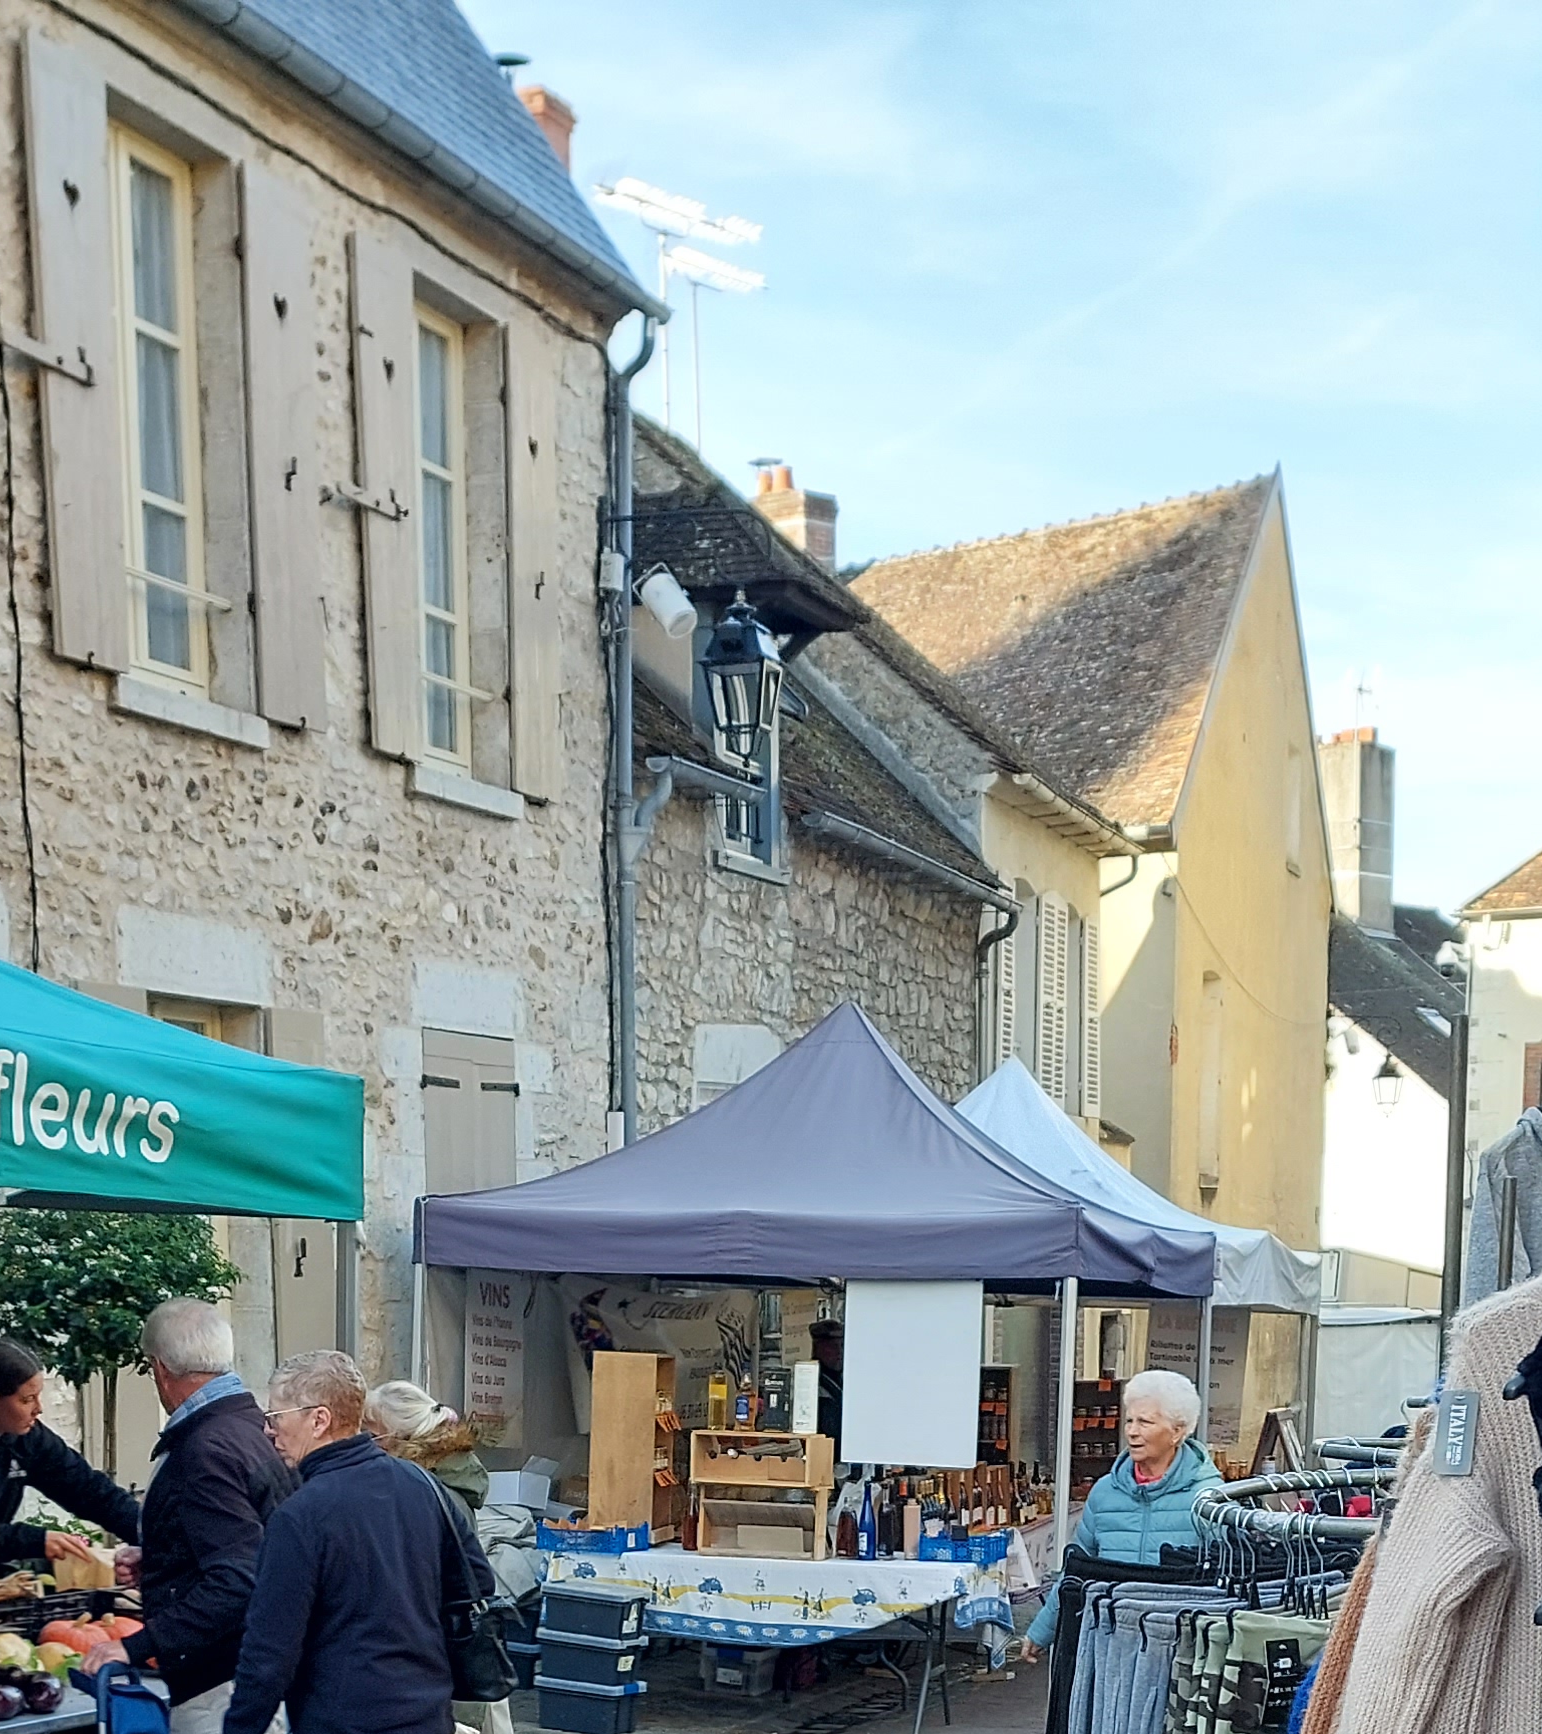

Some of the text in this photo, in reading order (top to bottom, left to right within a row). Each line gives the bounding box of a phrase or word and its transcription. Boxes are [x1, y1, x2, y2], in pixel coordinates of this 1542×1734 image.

[479, 1281, 510, 1309] VINS
[471, 1332, 483, 1346] Vins
[1185, 1342, 1196, 1351] de
[471, 1352, 483, 1365] Vins
[1217, 1358, 1234, 1366] mer
[471, 1371, 483, 1385] Vins
[470, 1391, 483, 1404] Vins
[1448, 1405, 1467, 1446] ITALY
